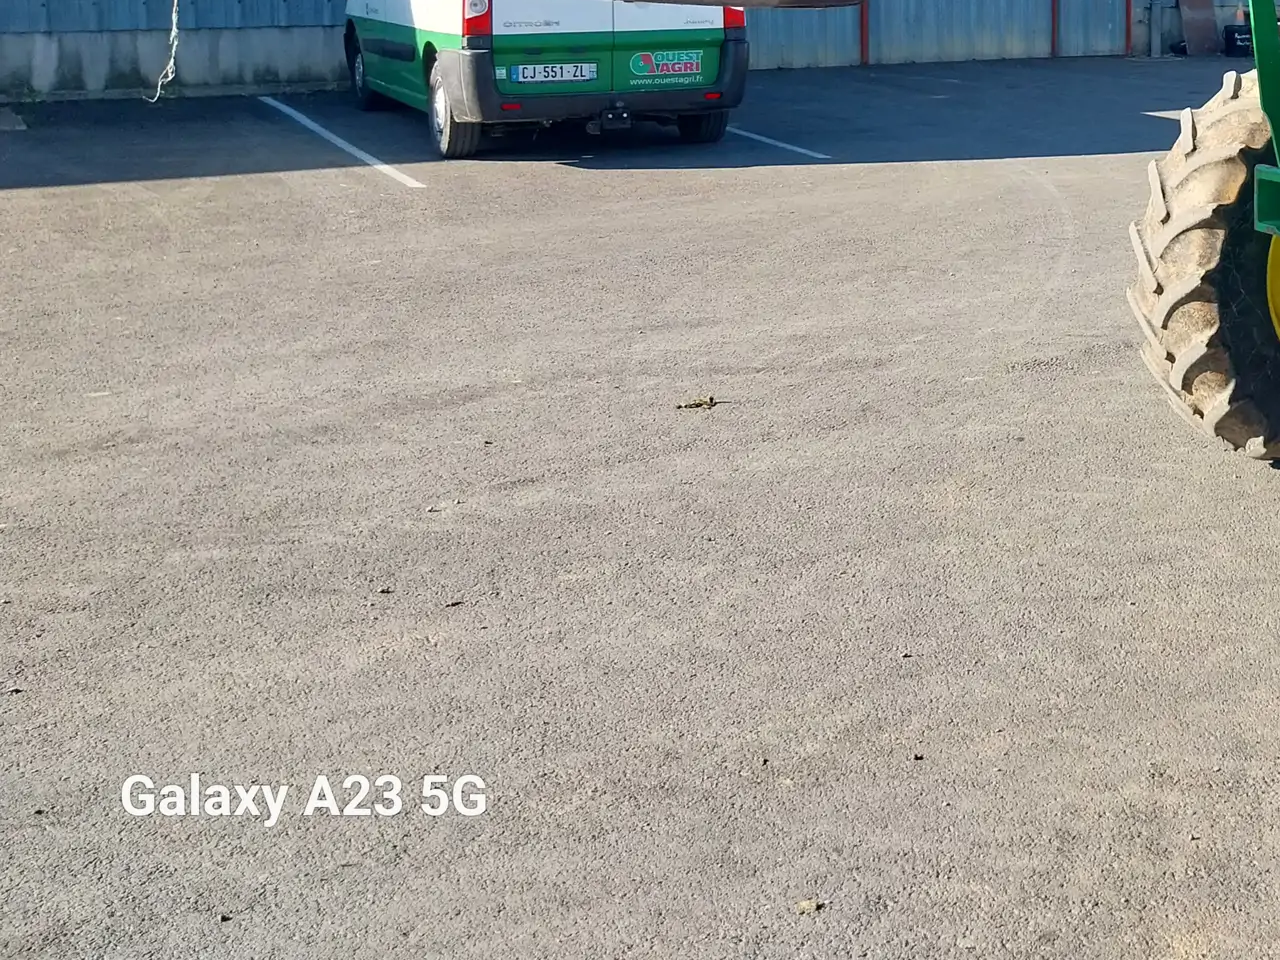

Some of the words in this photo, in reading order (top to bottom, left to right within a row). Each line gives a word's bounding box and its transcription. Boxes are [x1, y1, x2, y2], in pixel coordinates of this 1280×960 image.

[653, 50, 703, 63] OUEST
[659, 62, 701, 74] AGRI
[629, 75, 703, 85] www.ouestagri.fr
